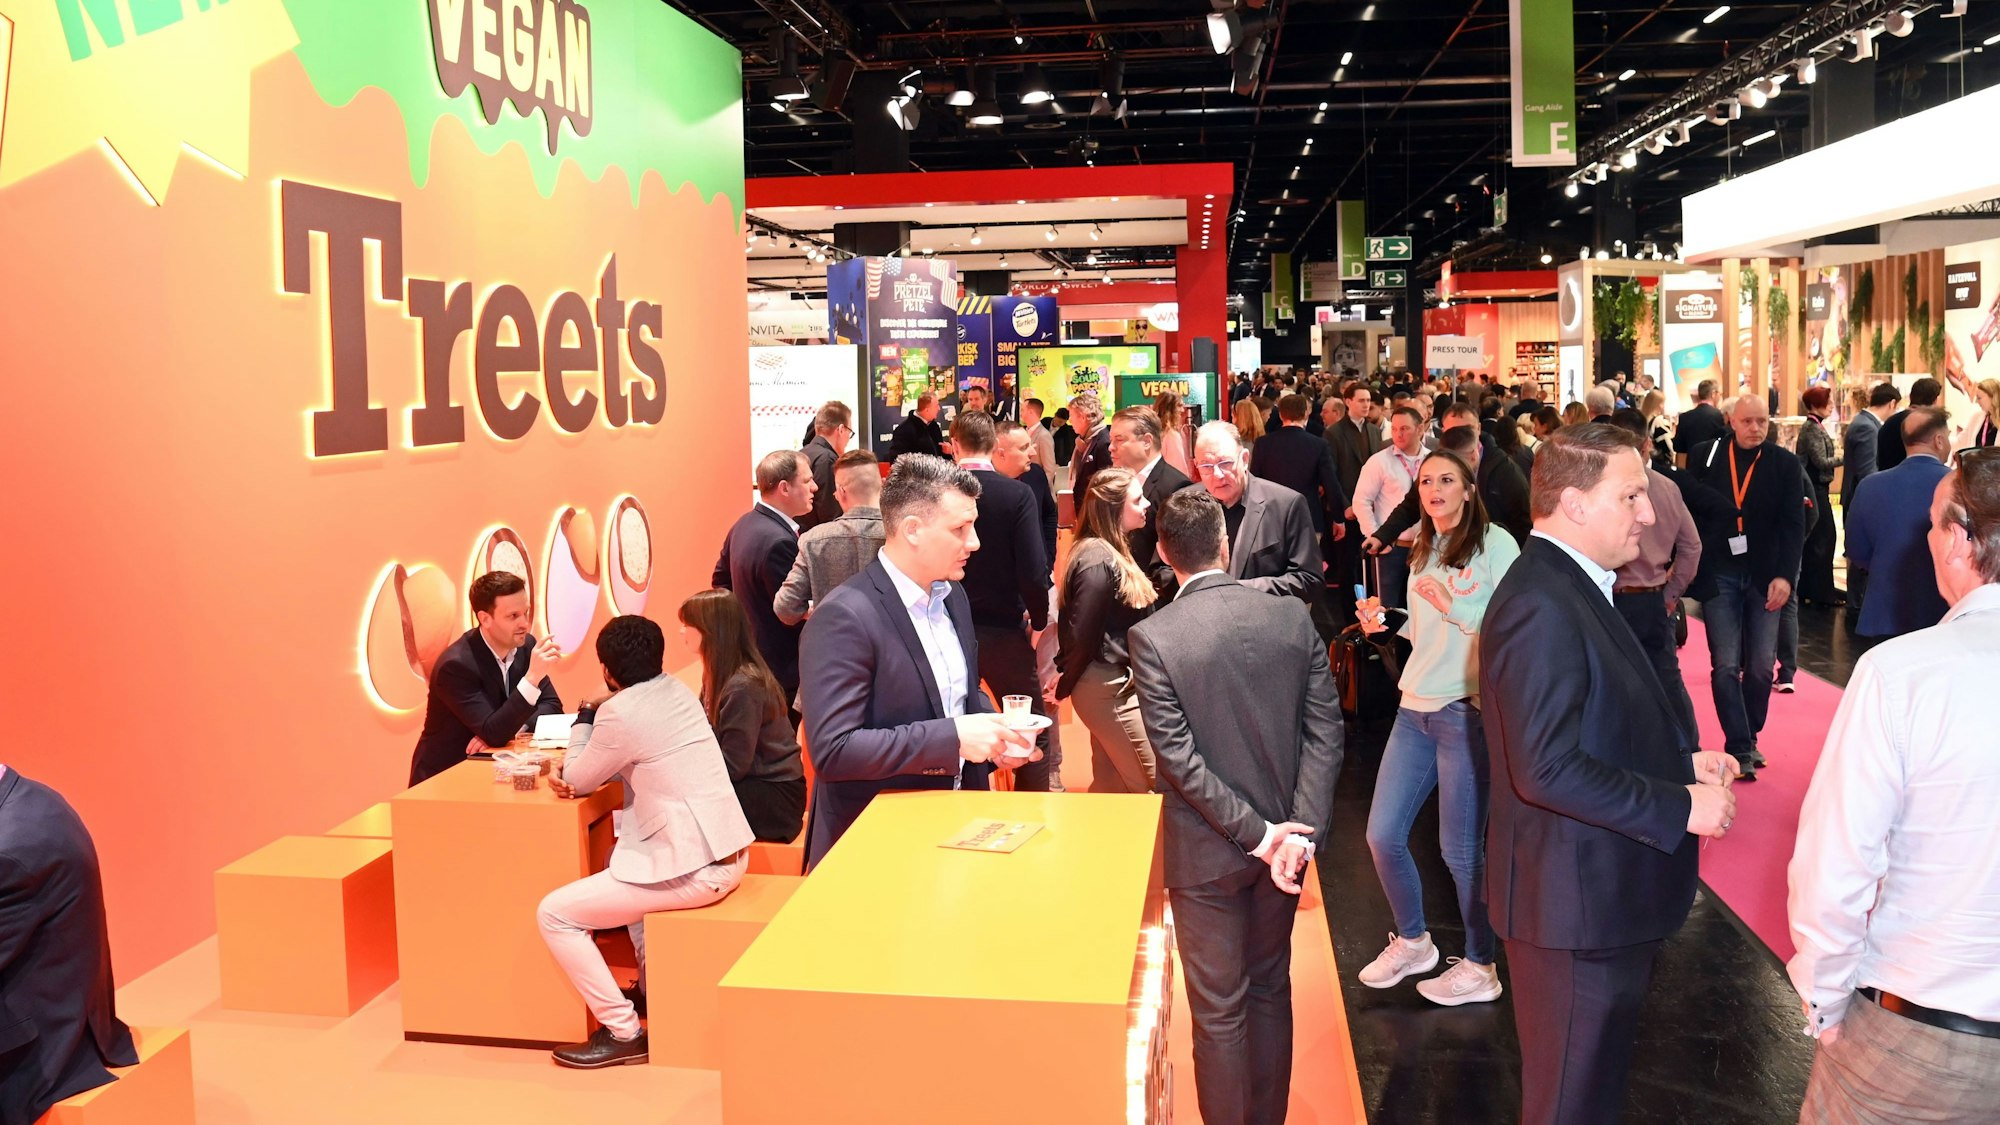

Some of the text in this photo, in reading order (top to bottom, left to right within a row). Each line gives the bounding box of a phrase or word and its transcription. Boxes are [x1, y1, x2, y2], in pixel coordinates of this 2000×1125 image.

[436, 0, 590, 119] VEGAN
[1550, 122, 1569, 153] E
[1351, 262, 1365, 277] D
[894, 284, 934, 301] PRETZEL
[281, 180, 667, 457] Treets
[748, 325, 785, 335] NVITA
[997, 355, 1016, 367] BIG
[1071, 371, 1100, 385] SOUR
[1141, 381, 1189, 396] VEGAN
[956, 822, 1006, 847] Treets
